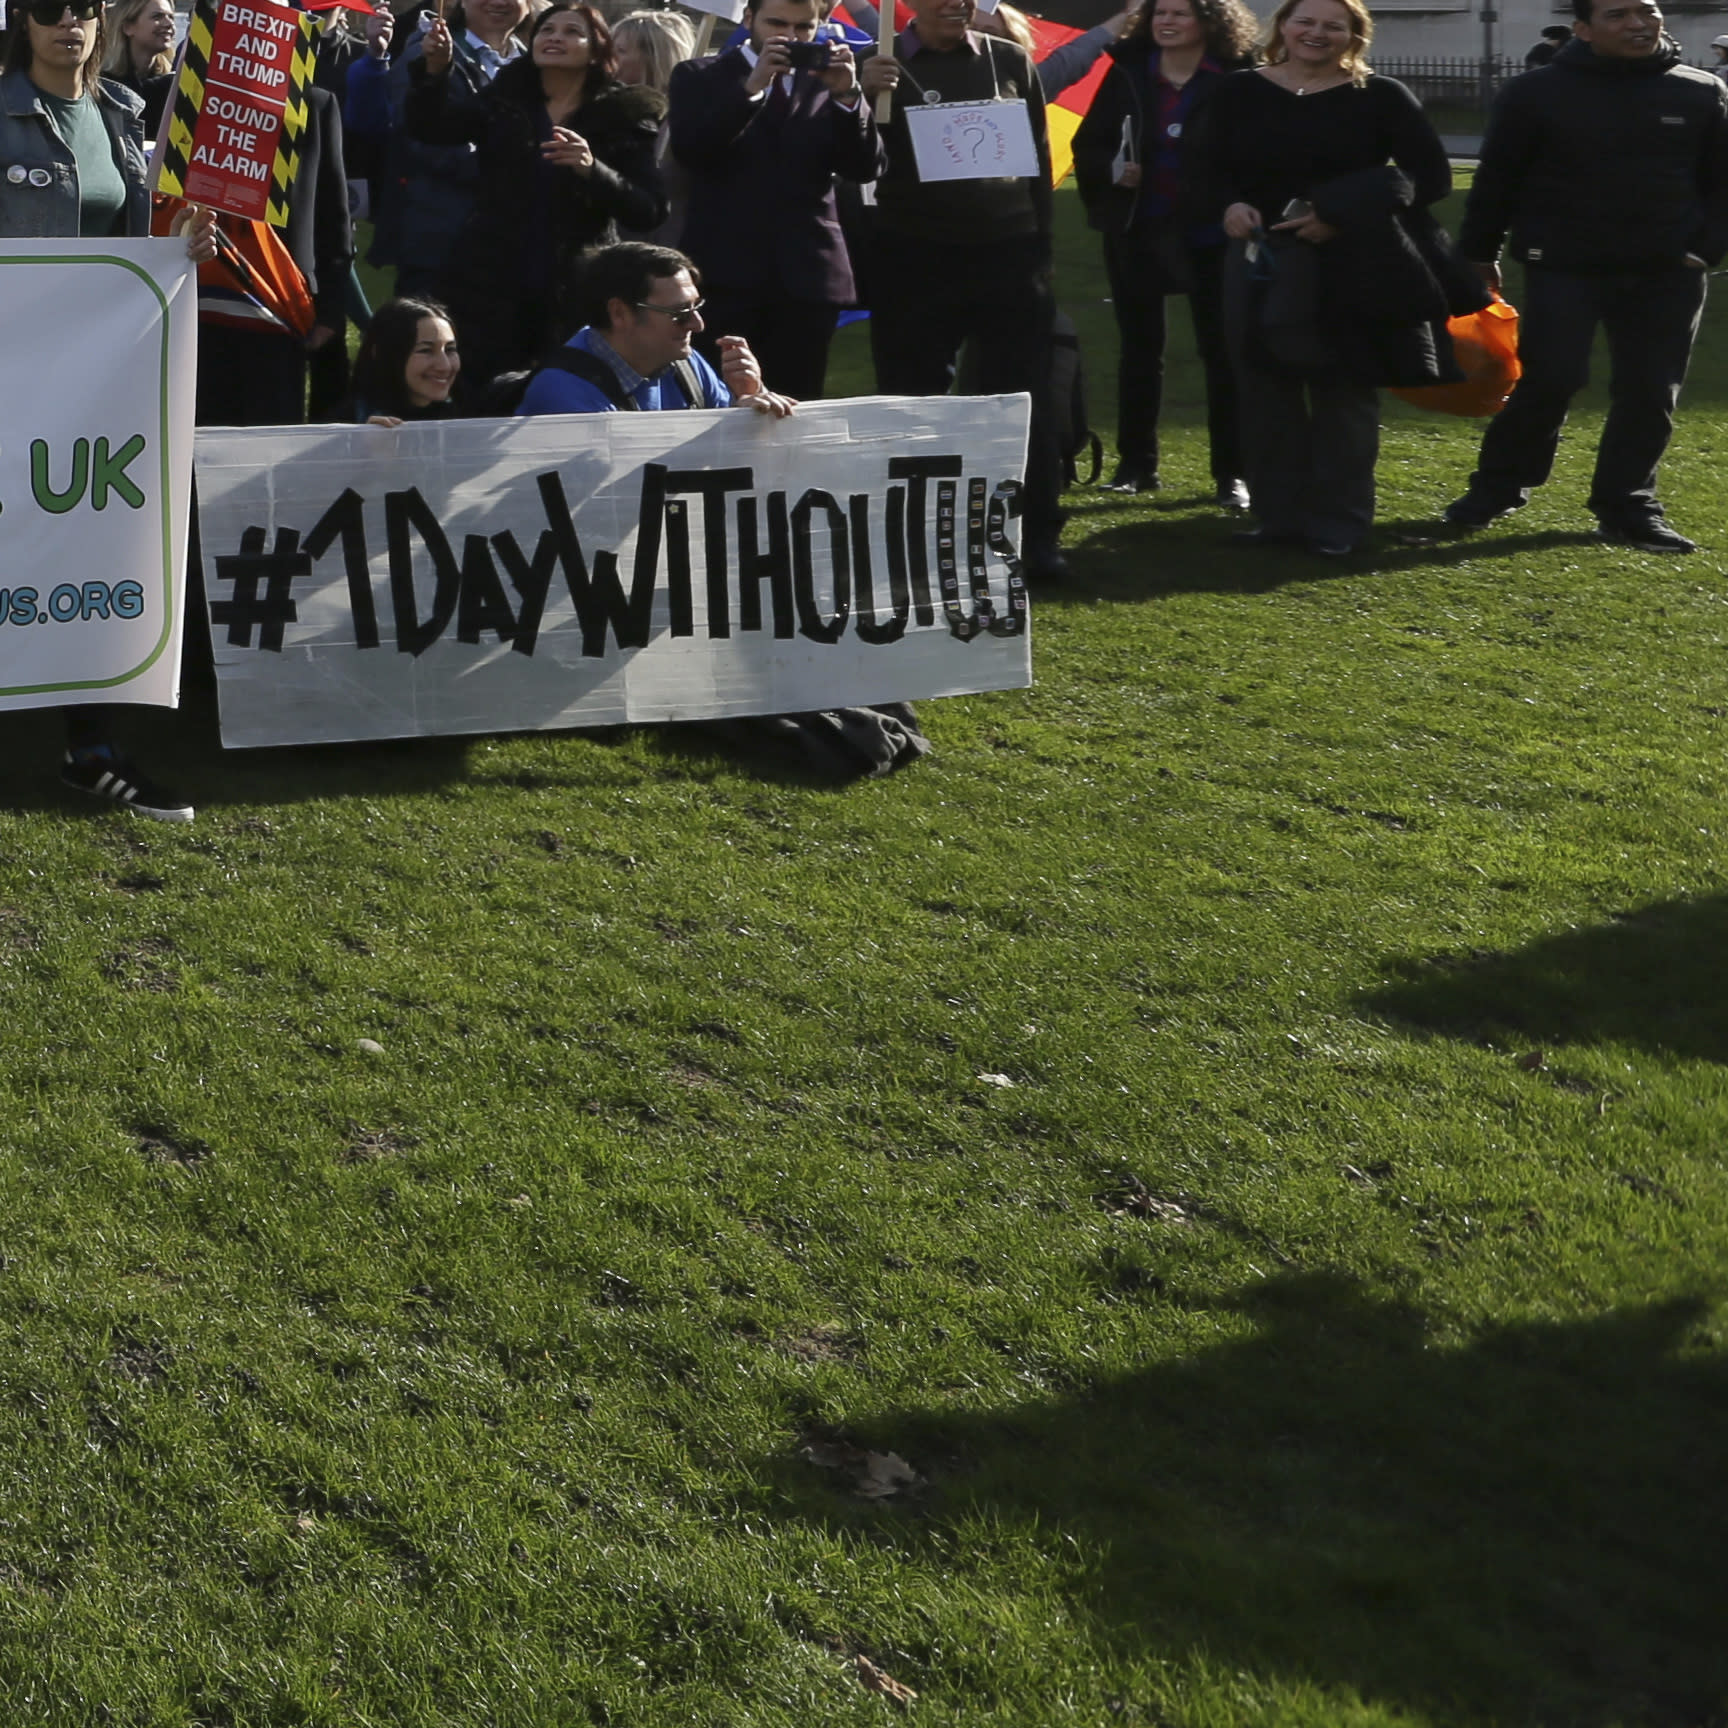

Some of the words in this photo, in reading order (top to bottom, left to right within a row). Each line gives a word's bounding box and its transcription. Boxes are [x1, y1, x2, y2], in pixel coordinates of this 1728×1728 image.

[222, 3, 296, 42] BREXIT
[235, 33, 278, 61] AND
[216, 51, 286, 88] TRUMP
[205, 96, 278, 133] SOUND
[217, 124, 257, 153] THE
[193, 144, 268, 182] ALARM
[30, 432, 147, 515] UK
